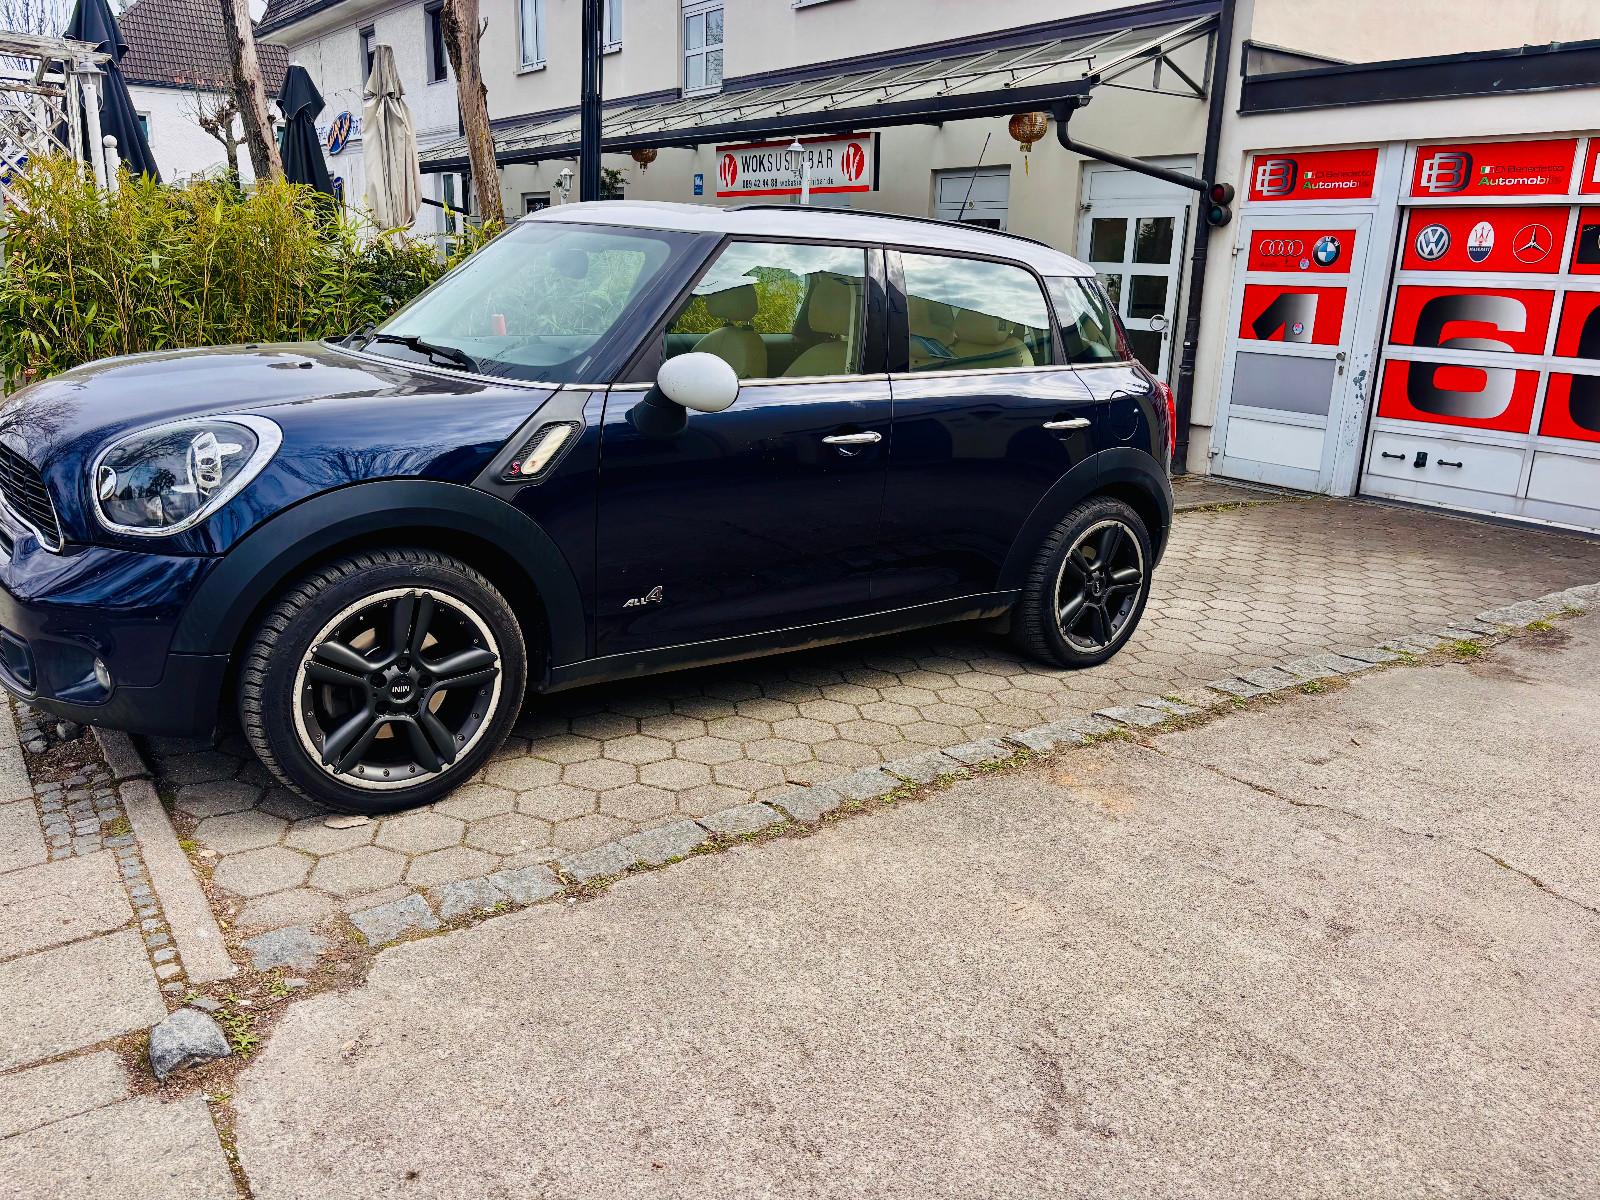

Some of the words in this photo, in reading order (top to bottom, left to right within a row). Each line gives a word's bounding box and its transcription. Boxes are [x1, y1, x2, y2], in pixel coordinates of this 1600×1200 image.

[1303, 180, 1368, 190] Automobi
[622, 585, 663, 608] ALL4
[392, 685, 410, 693] MINI
